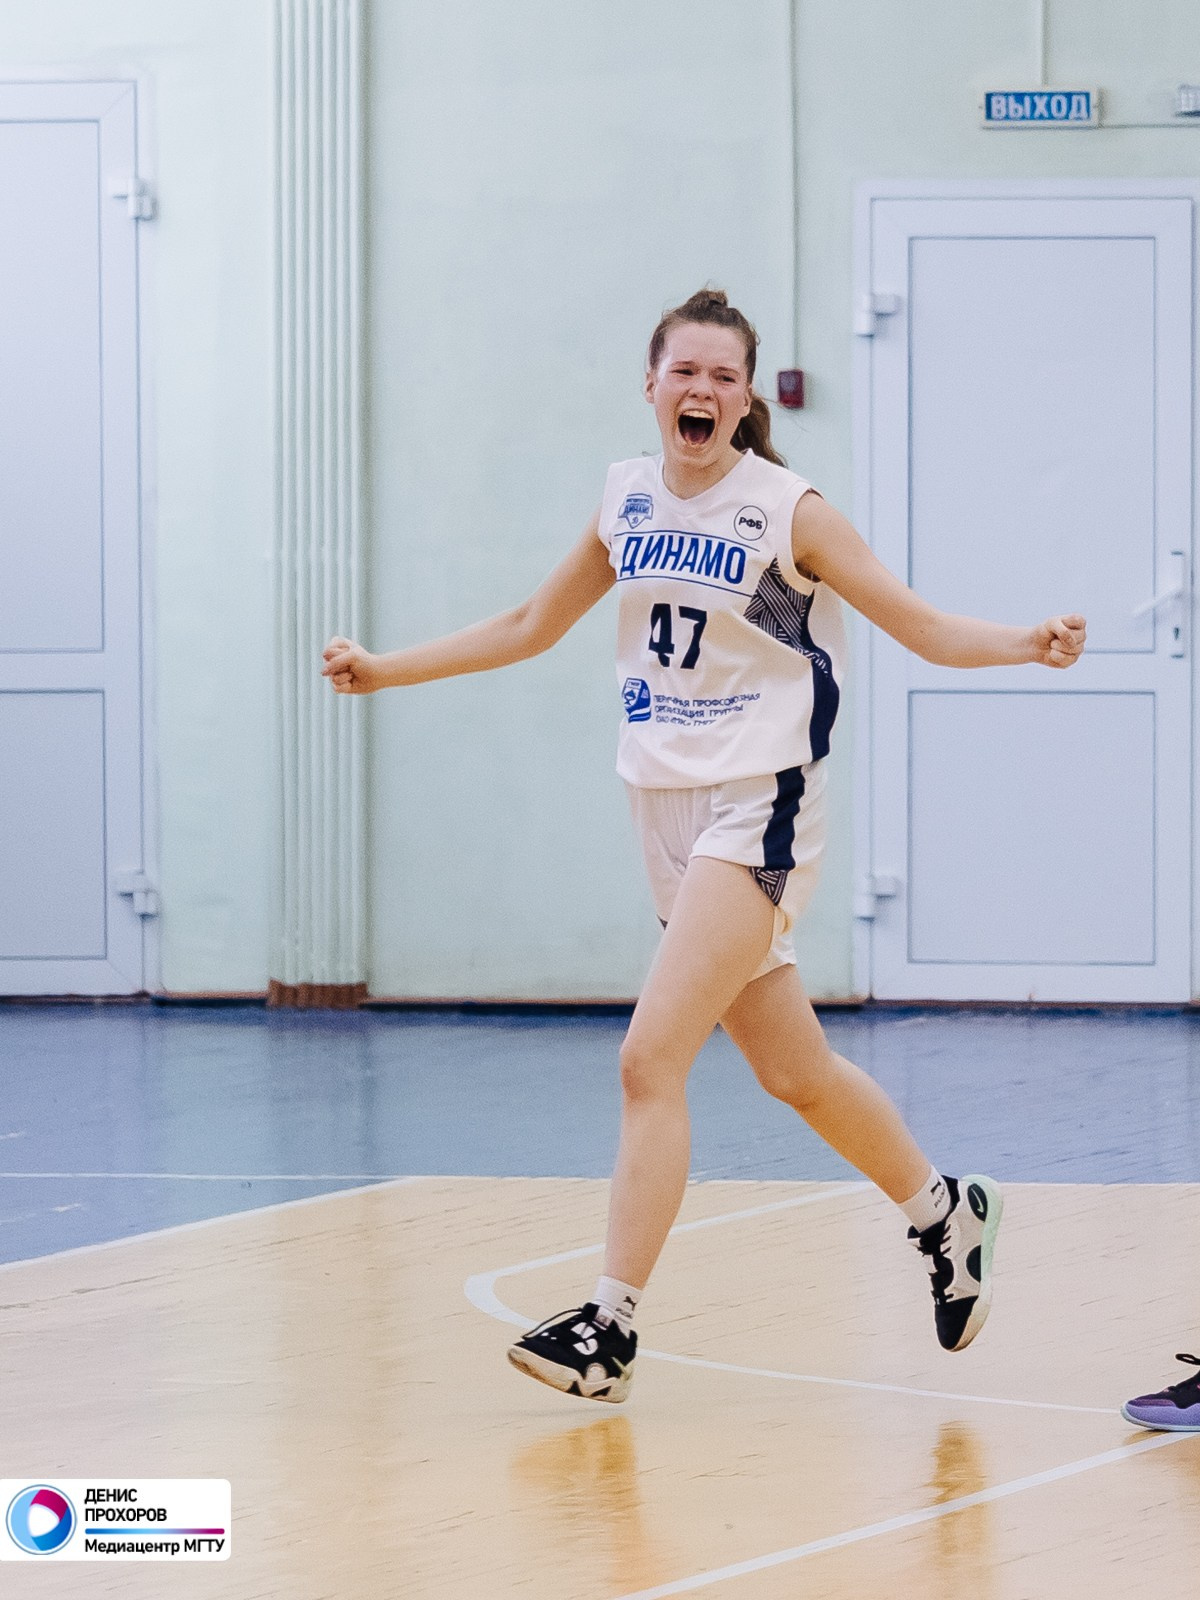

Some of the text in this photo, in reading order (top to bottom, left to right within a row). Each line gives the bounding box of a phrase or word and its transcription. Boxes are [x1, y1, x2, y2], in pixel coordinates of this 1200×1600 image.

[990, 94, 1088, 120] ВЫХОД
[738, 516, 763, 530] РФБ
[619, 534, 746, 585] ДИНАМО
[648, 603, 707, 670] 47
